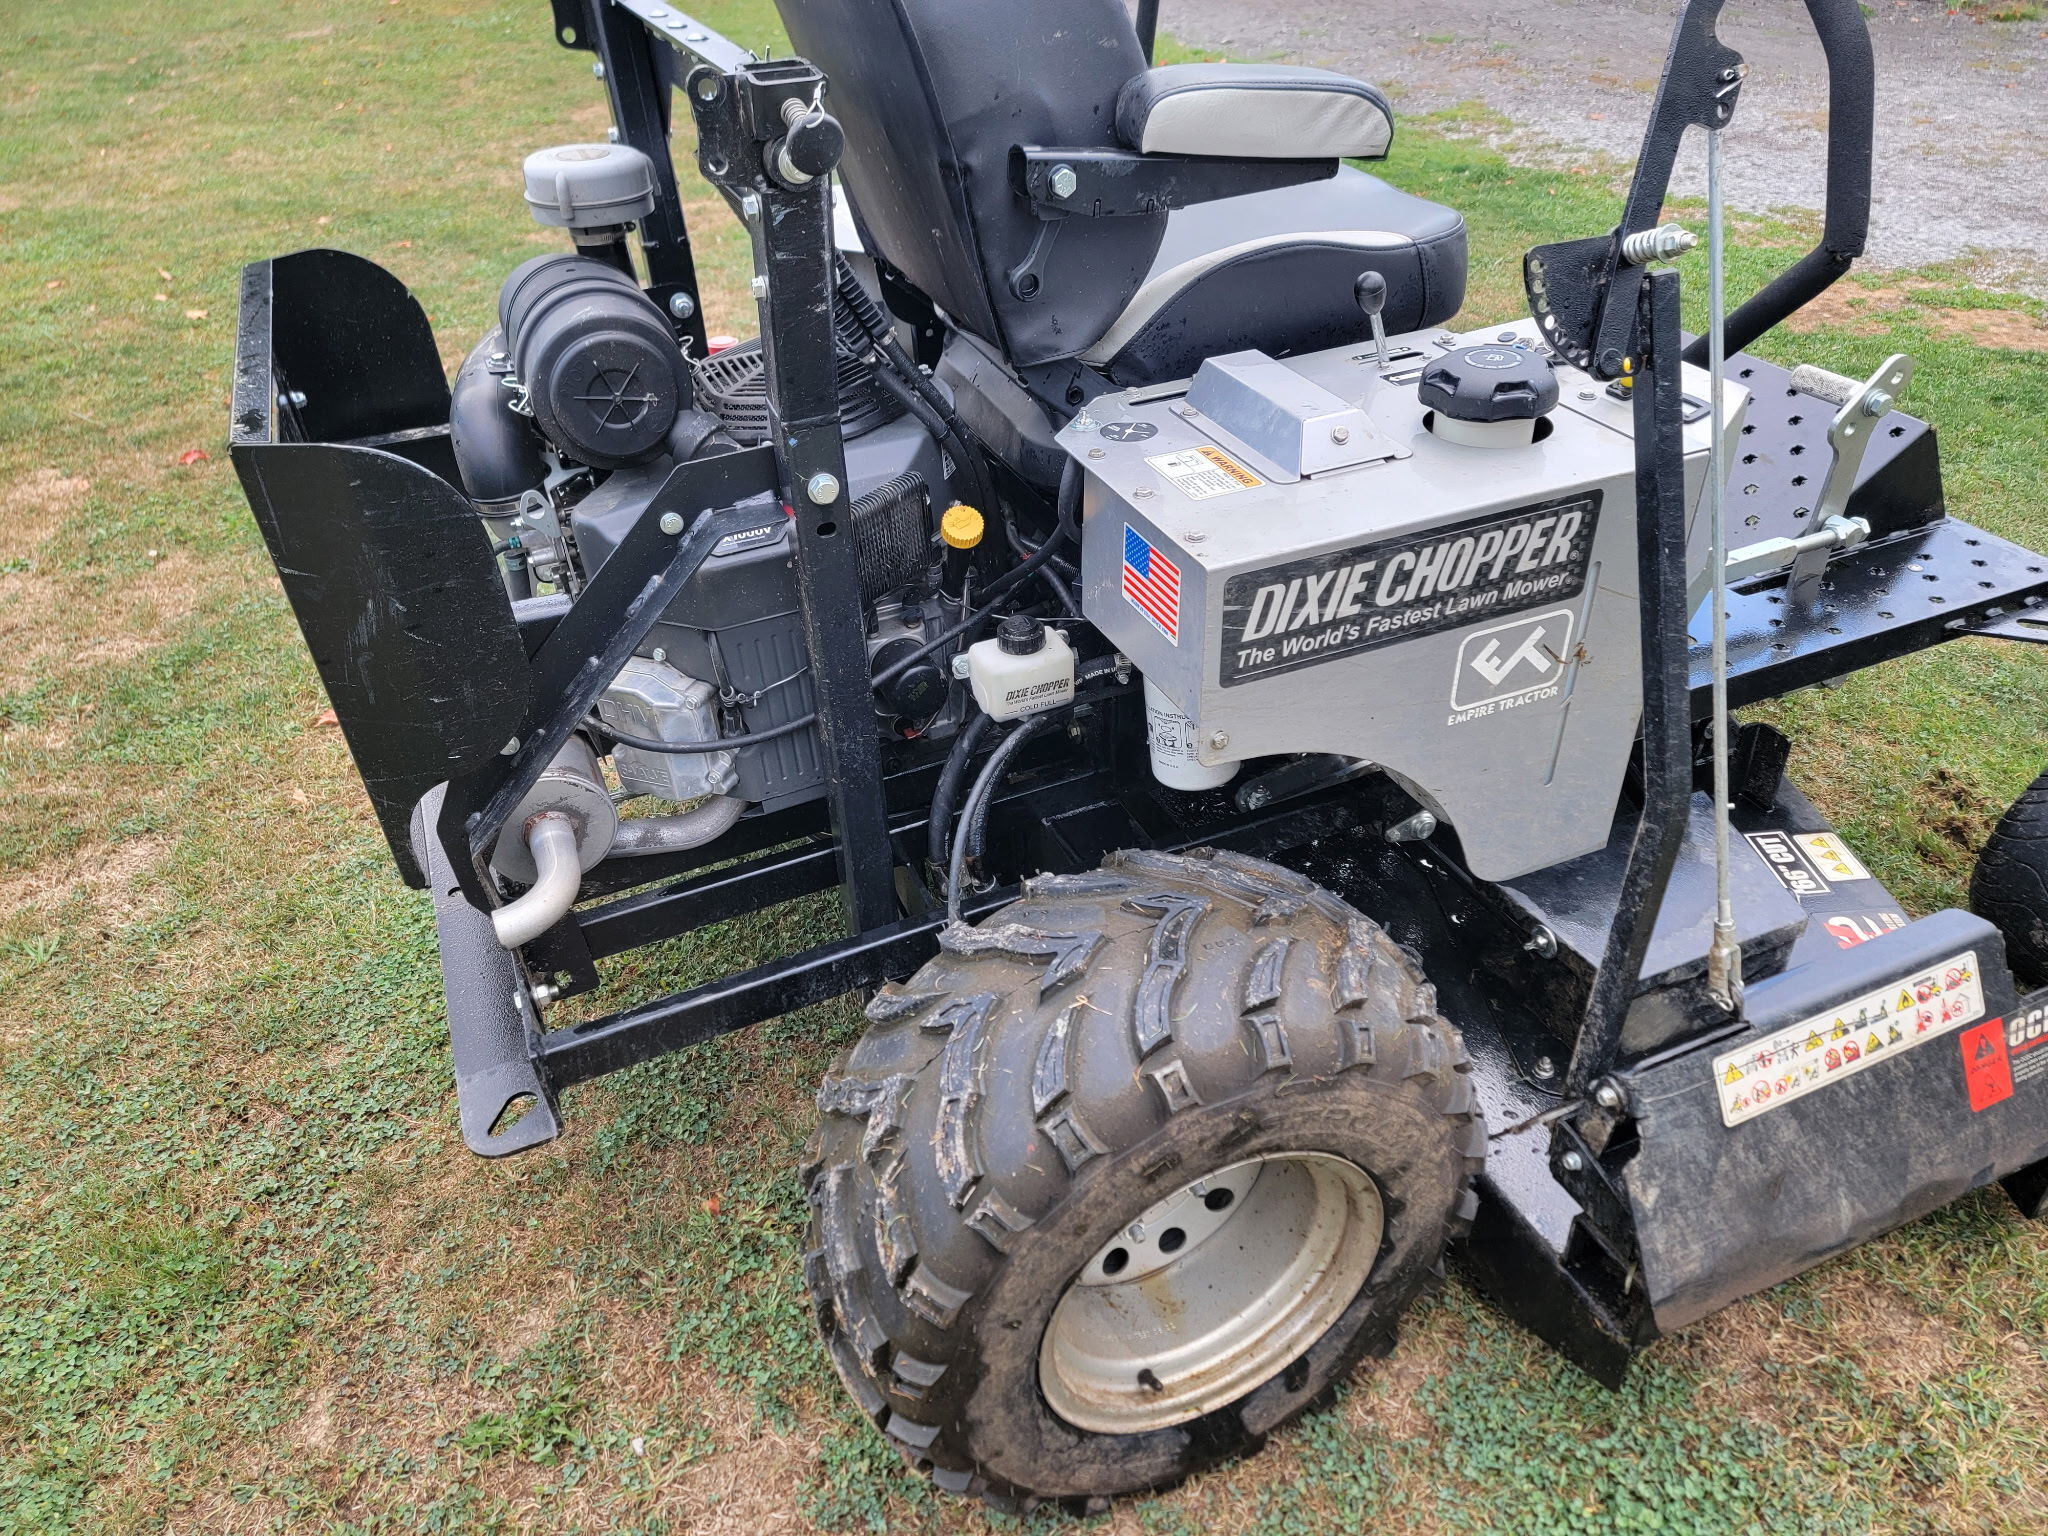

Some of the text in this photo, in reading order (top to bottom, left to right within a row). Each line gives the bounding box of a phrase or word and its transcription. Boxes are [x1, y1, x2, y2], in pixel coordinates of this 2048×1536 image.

[1211, 456, 1254, 485] WARNING
[1241, 510, 1583, 642] DIXIE CHOPPER
[1237, 571, 1568, 669] The World's Fastest Lawn Mower
[1085, 669, 1103, 680] MADE
[1005, 678, 1071, 702] DIXIE CHOPPER
[1040, 698, 1057, 708] FULL
[1447, 685, 1559, 726] EMPIRE TRACTOR
[1755, 836, 1795, 864] CUT
[2008, 1005, 2048, 1047] OC
